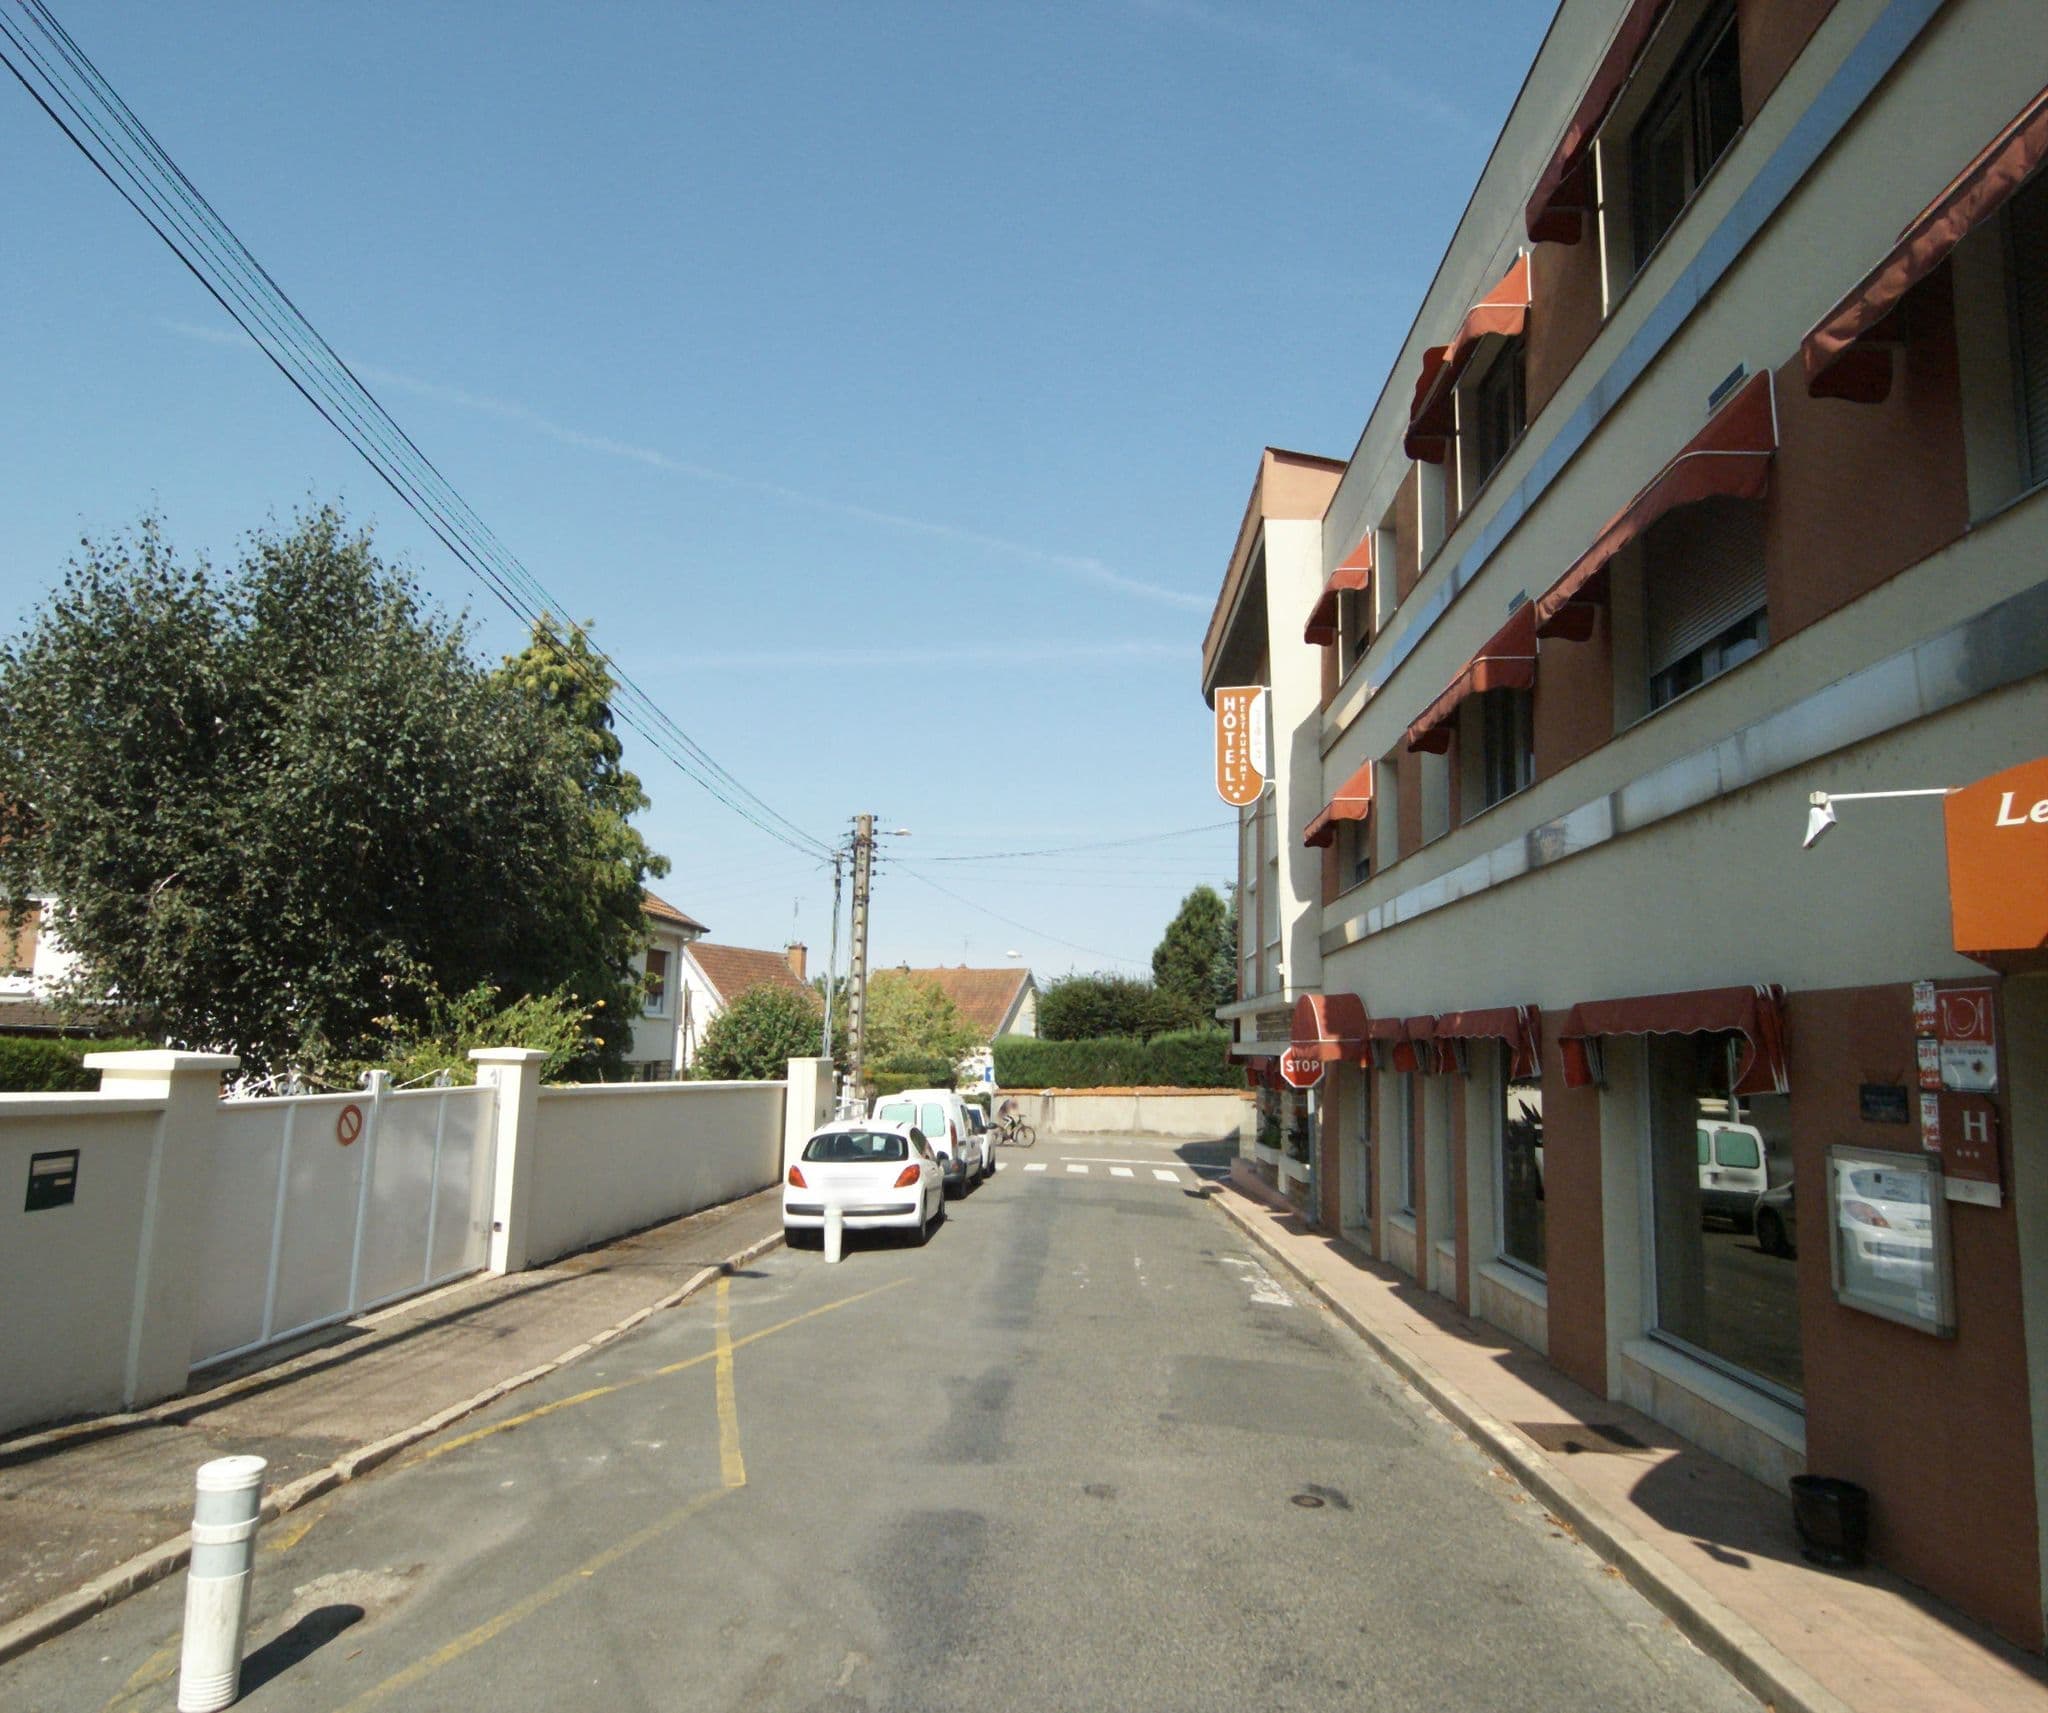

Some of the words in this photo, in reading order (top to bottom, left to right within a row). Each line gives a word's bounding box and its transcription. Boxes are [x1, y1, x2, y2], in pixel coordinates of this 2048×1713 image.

[1239, 696, 1248, 781] RESTAURANT
[1285, 1060, 1320, 1073] STOP
[1963, 1110, 1988, 1142] H
